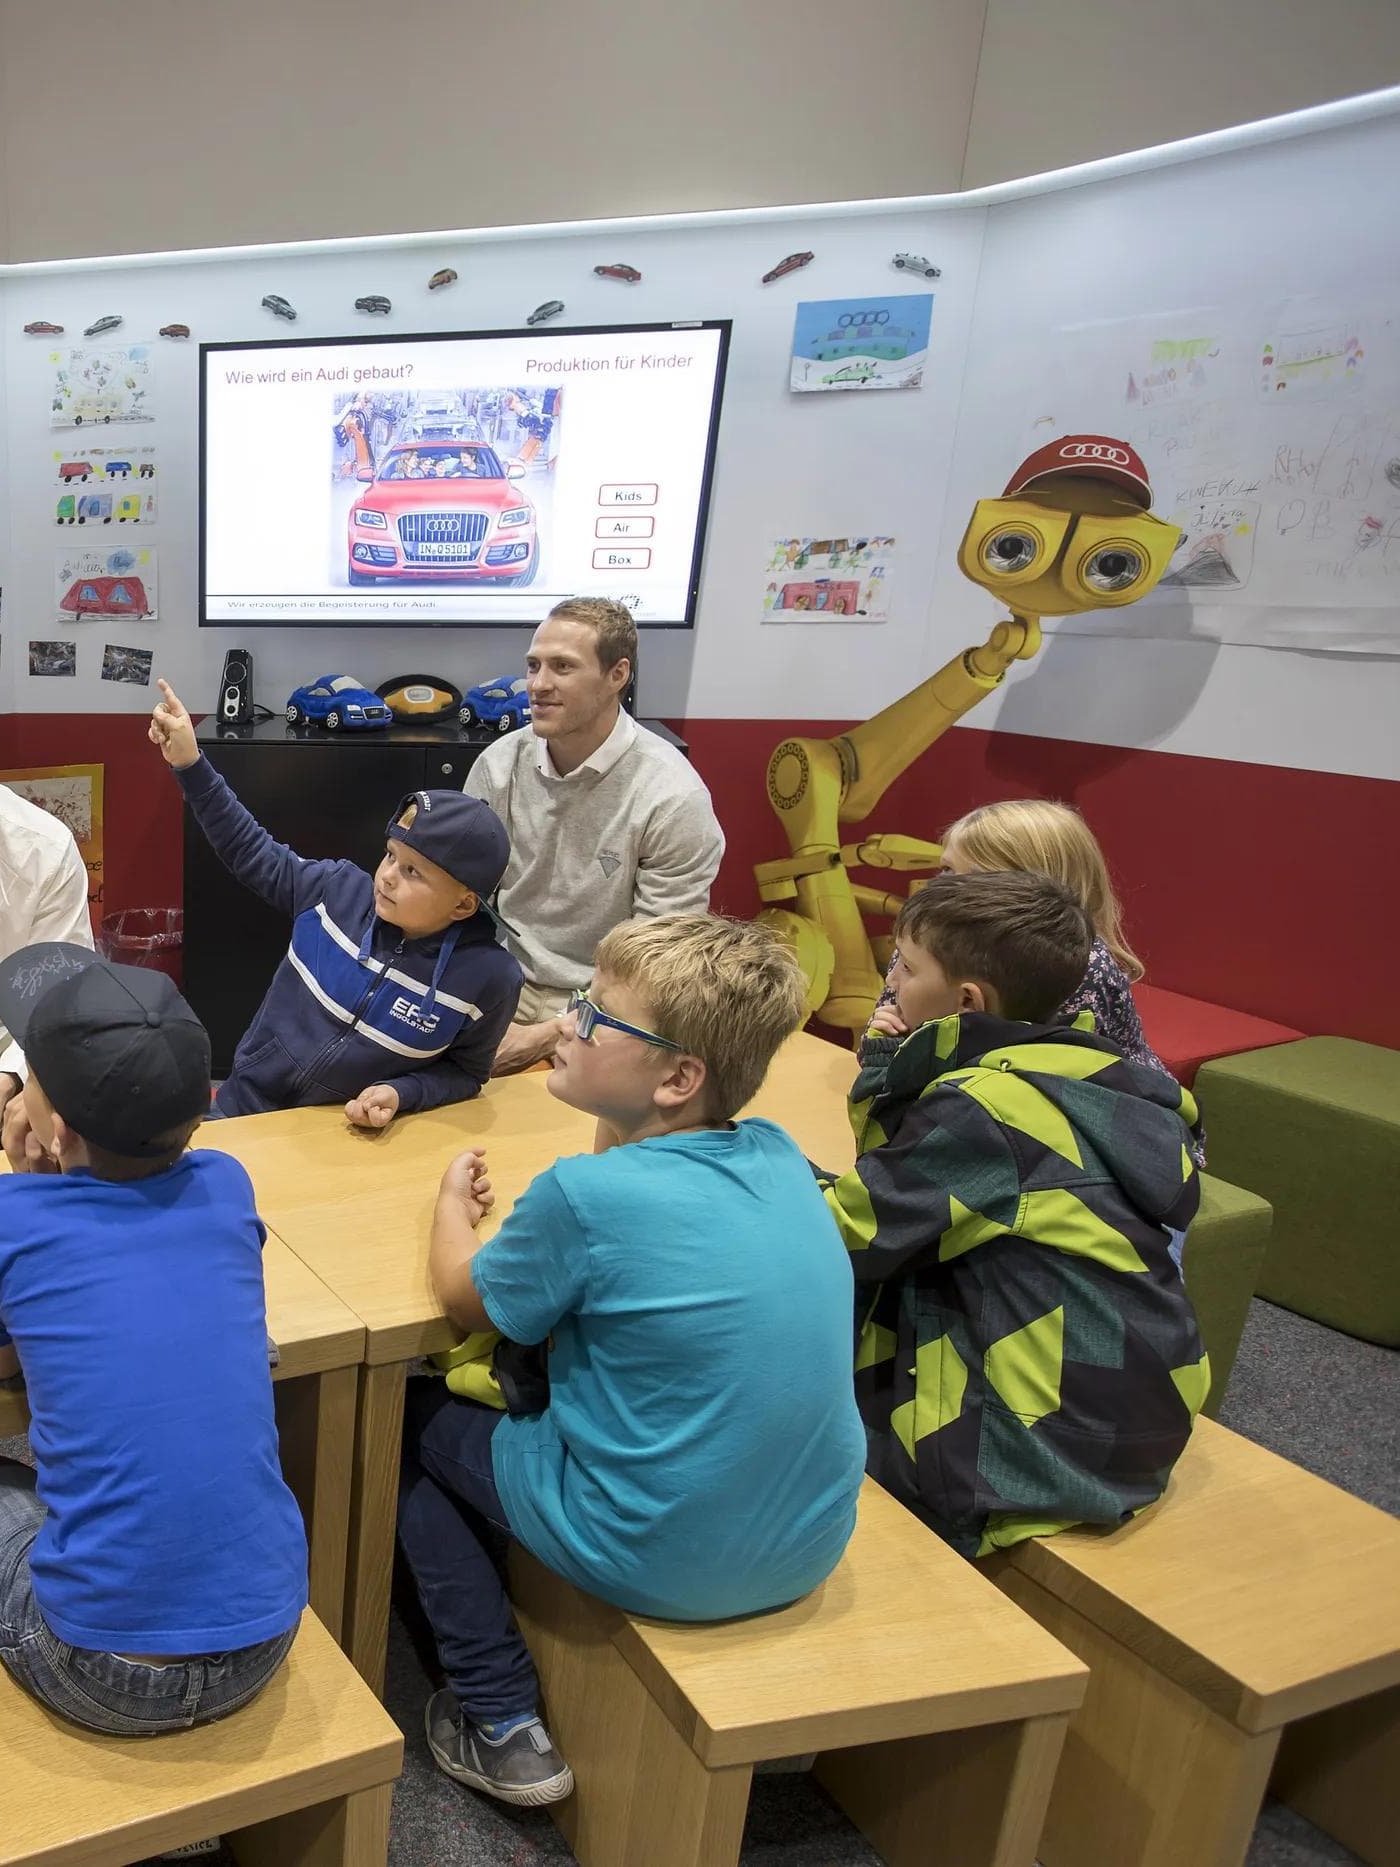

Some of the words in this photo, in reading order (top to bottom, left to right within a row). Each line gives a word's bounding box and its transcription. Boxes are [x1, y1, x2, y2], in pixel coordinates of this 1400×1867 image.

[526, 357, 610, 373] Produktion
[615, 355, 636, 370] für
[640, 354, 693, 369] Kinder
[225, 370, 253, 384] Wie
[257, 369, 286, 383] wird
[291, 368, 312, 382] ein
[316, 366, 349, 381] Audi
[354, 364, 414, 383] gebaut?
[615, 491, 642, 501] Kids
[613, 522, 631, 532] Air
[608, 554, 632, 565] Box
[389, 1009, 435, 1034] INGOLSTADT
